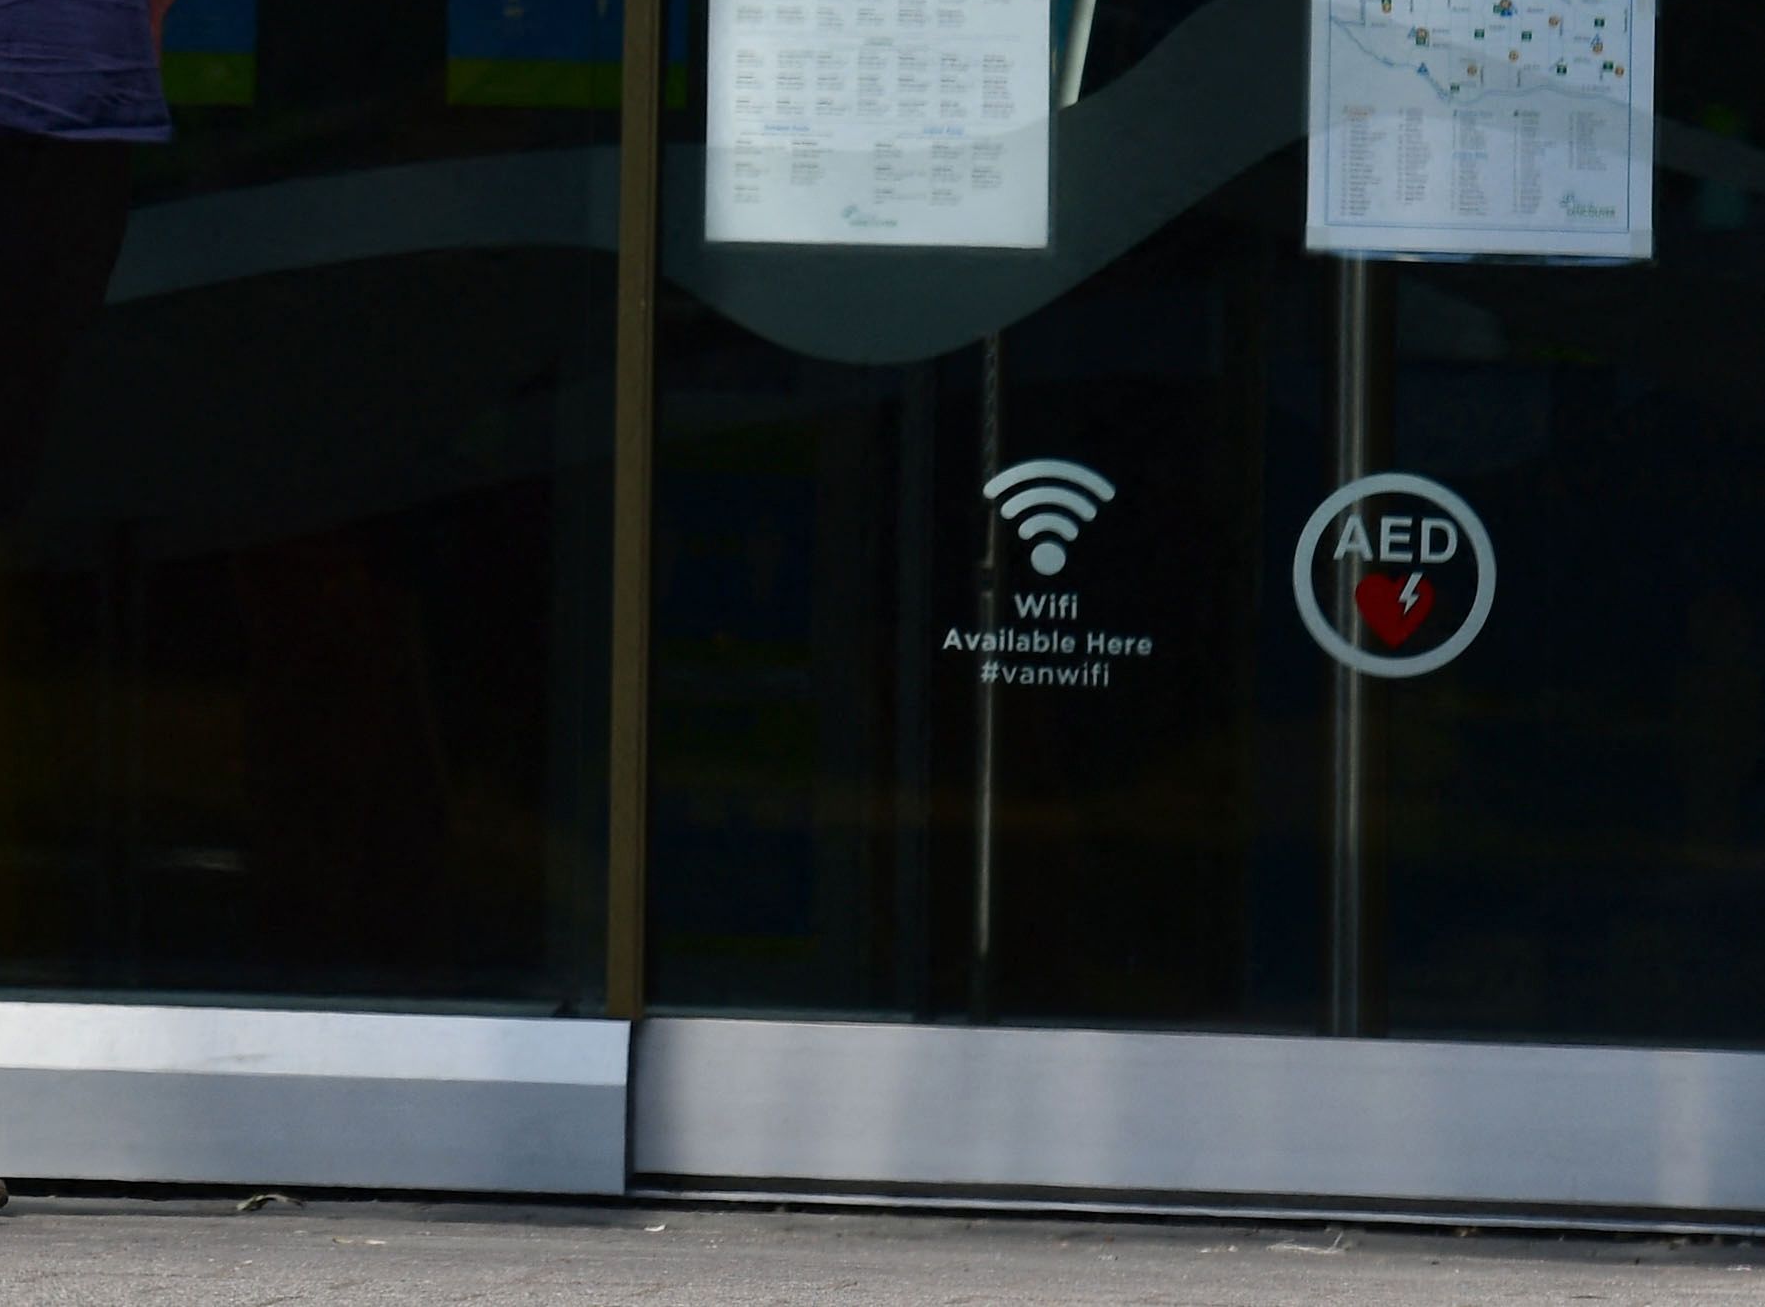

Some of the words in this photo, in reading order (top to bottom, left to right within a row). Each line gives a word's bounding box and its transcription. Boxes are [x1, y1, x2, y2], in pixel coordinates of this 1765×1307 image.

[1332, 516, 1458, 564] AED
[1012, 591, 1079, 620] Wifi
[941, 626, 1076, 654] Available
[1086, 630, 1154, 657] Here
[979, 660, 1110, 688] #vanwifi
